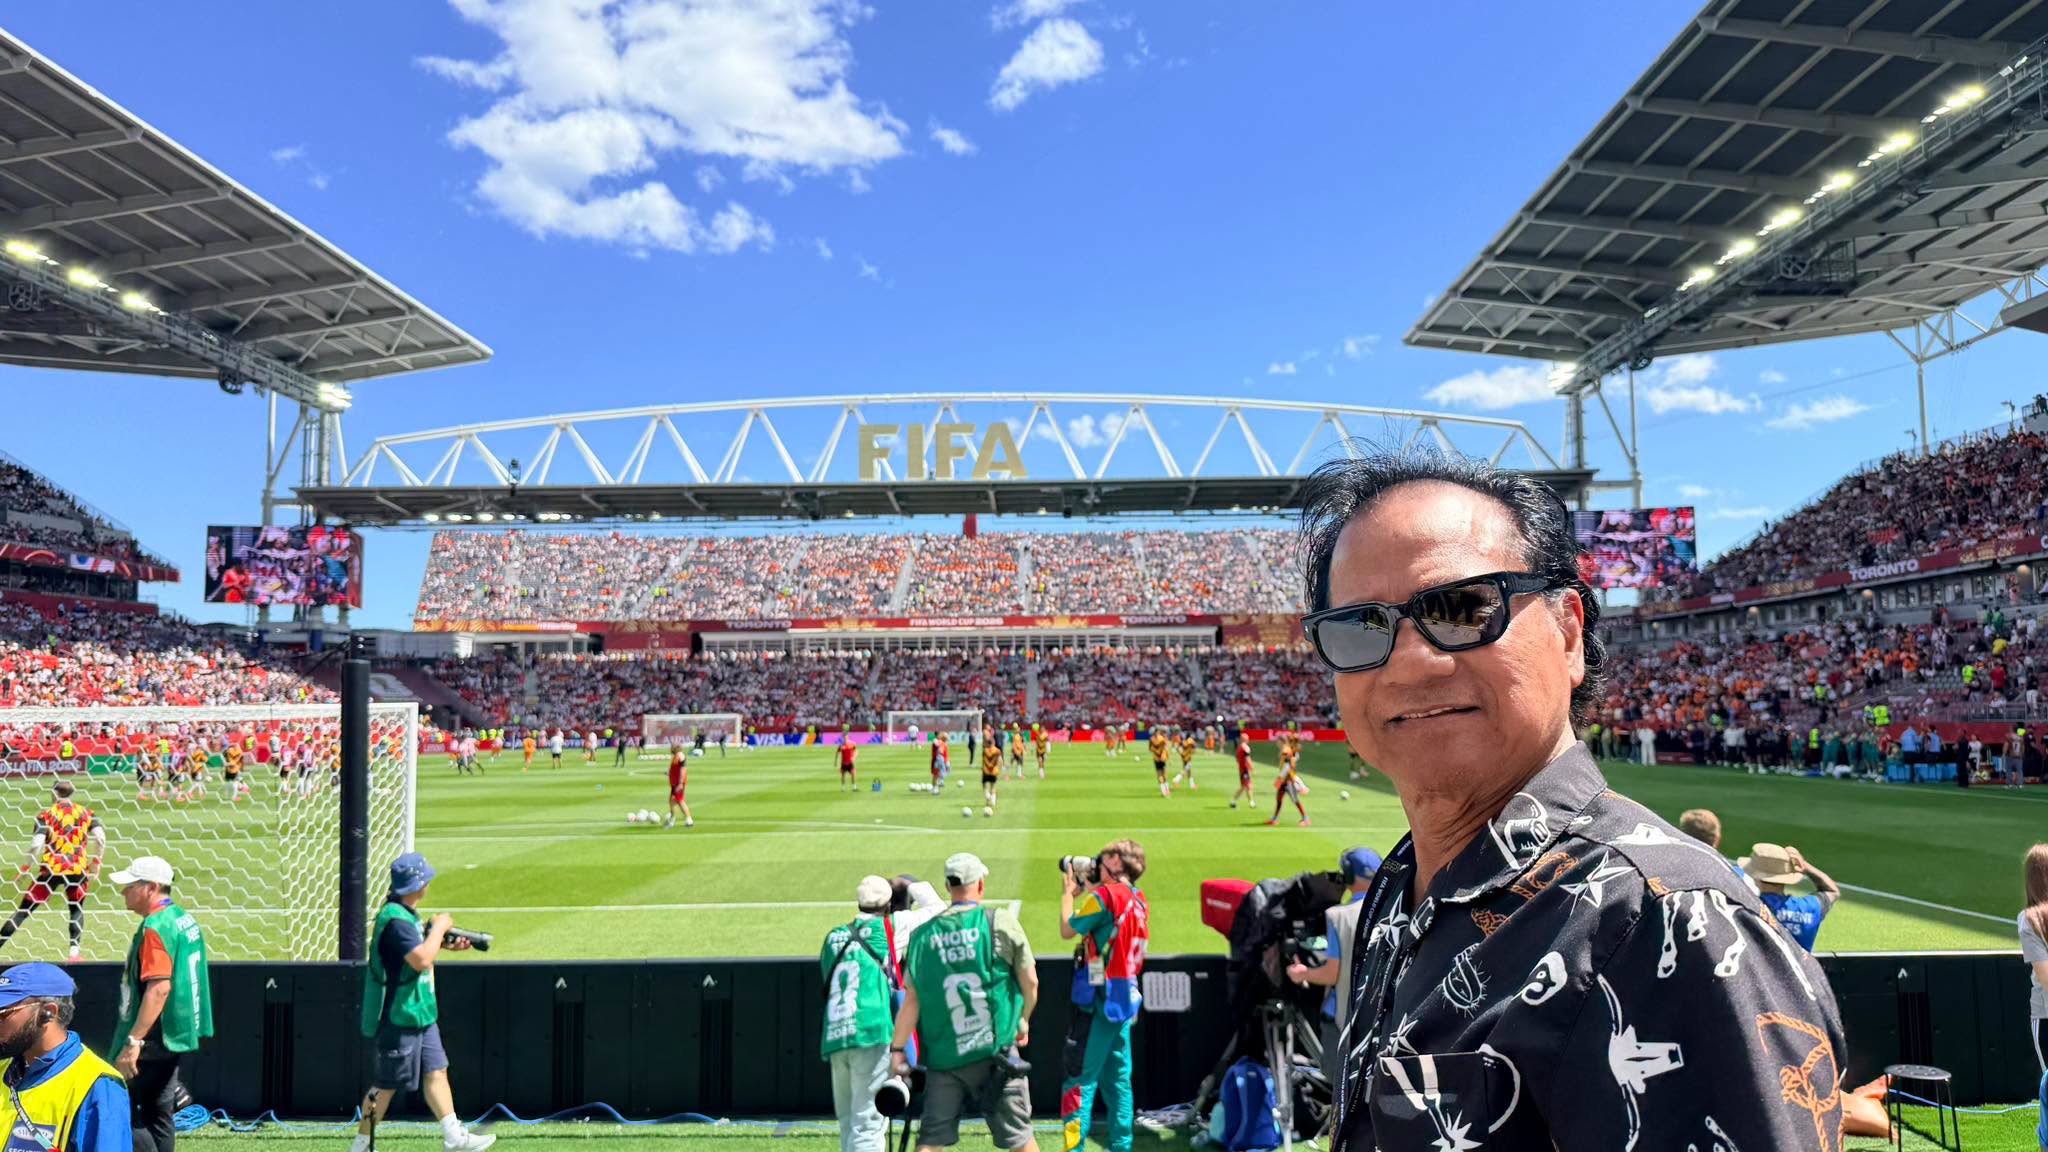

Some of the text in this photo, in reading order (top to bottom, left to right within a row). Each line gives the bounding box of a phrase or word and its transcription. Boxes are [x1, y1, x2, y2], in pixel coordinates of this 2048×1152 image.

[858, 422, 1028, 480] FIFA
[1849, 559, 1919, 581] TORONTO
[726, 619, 792, 629] TORONTO
[910, 618, 927, 627] FIFA
[928, 617, 958, 627] WORLD
[959, 617, 975, 627] CUP
[1120, 615, 1187, 624] TORONTO
[755, 733, 785, 745] VISA
[930, 928, 979, 950] PHOTO
